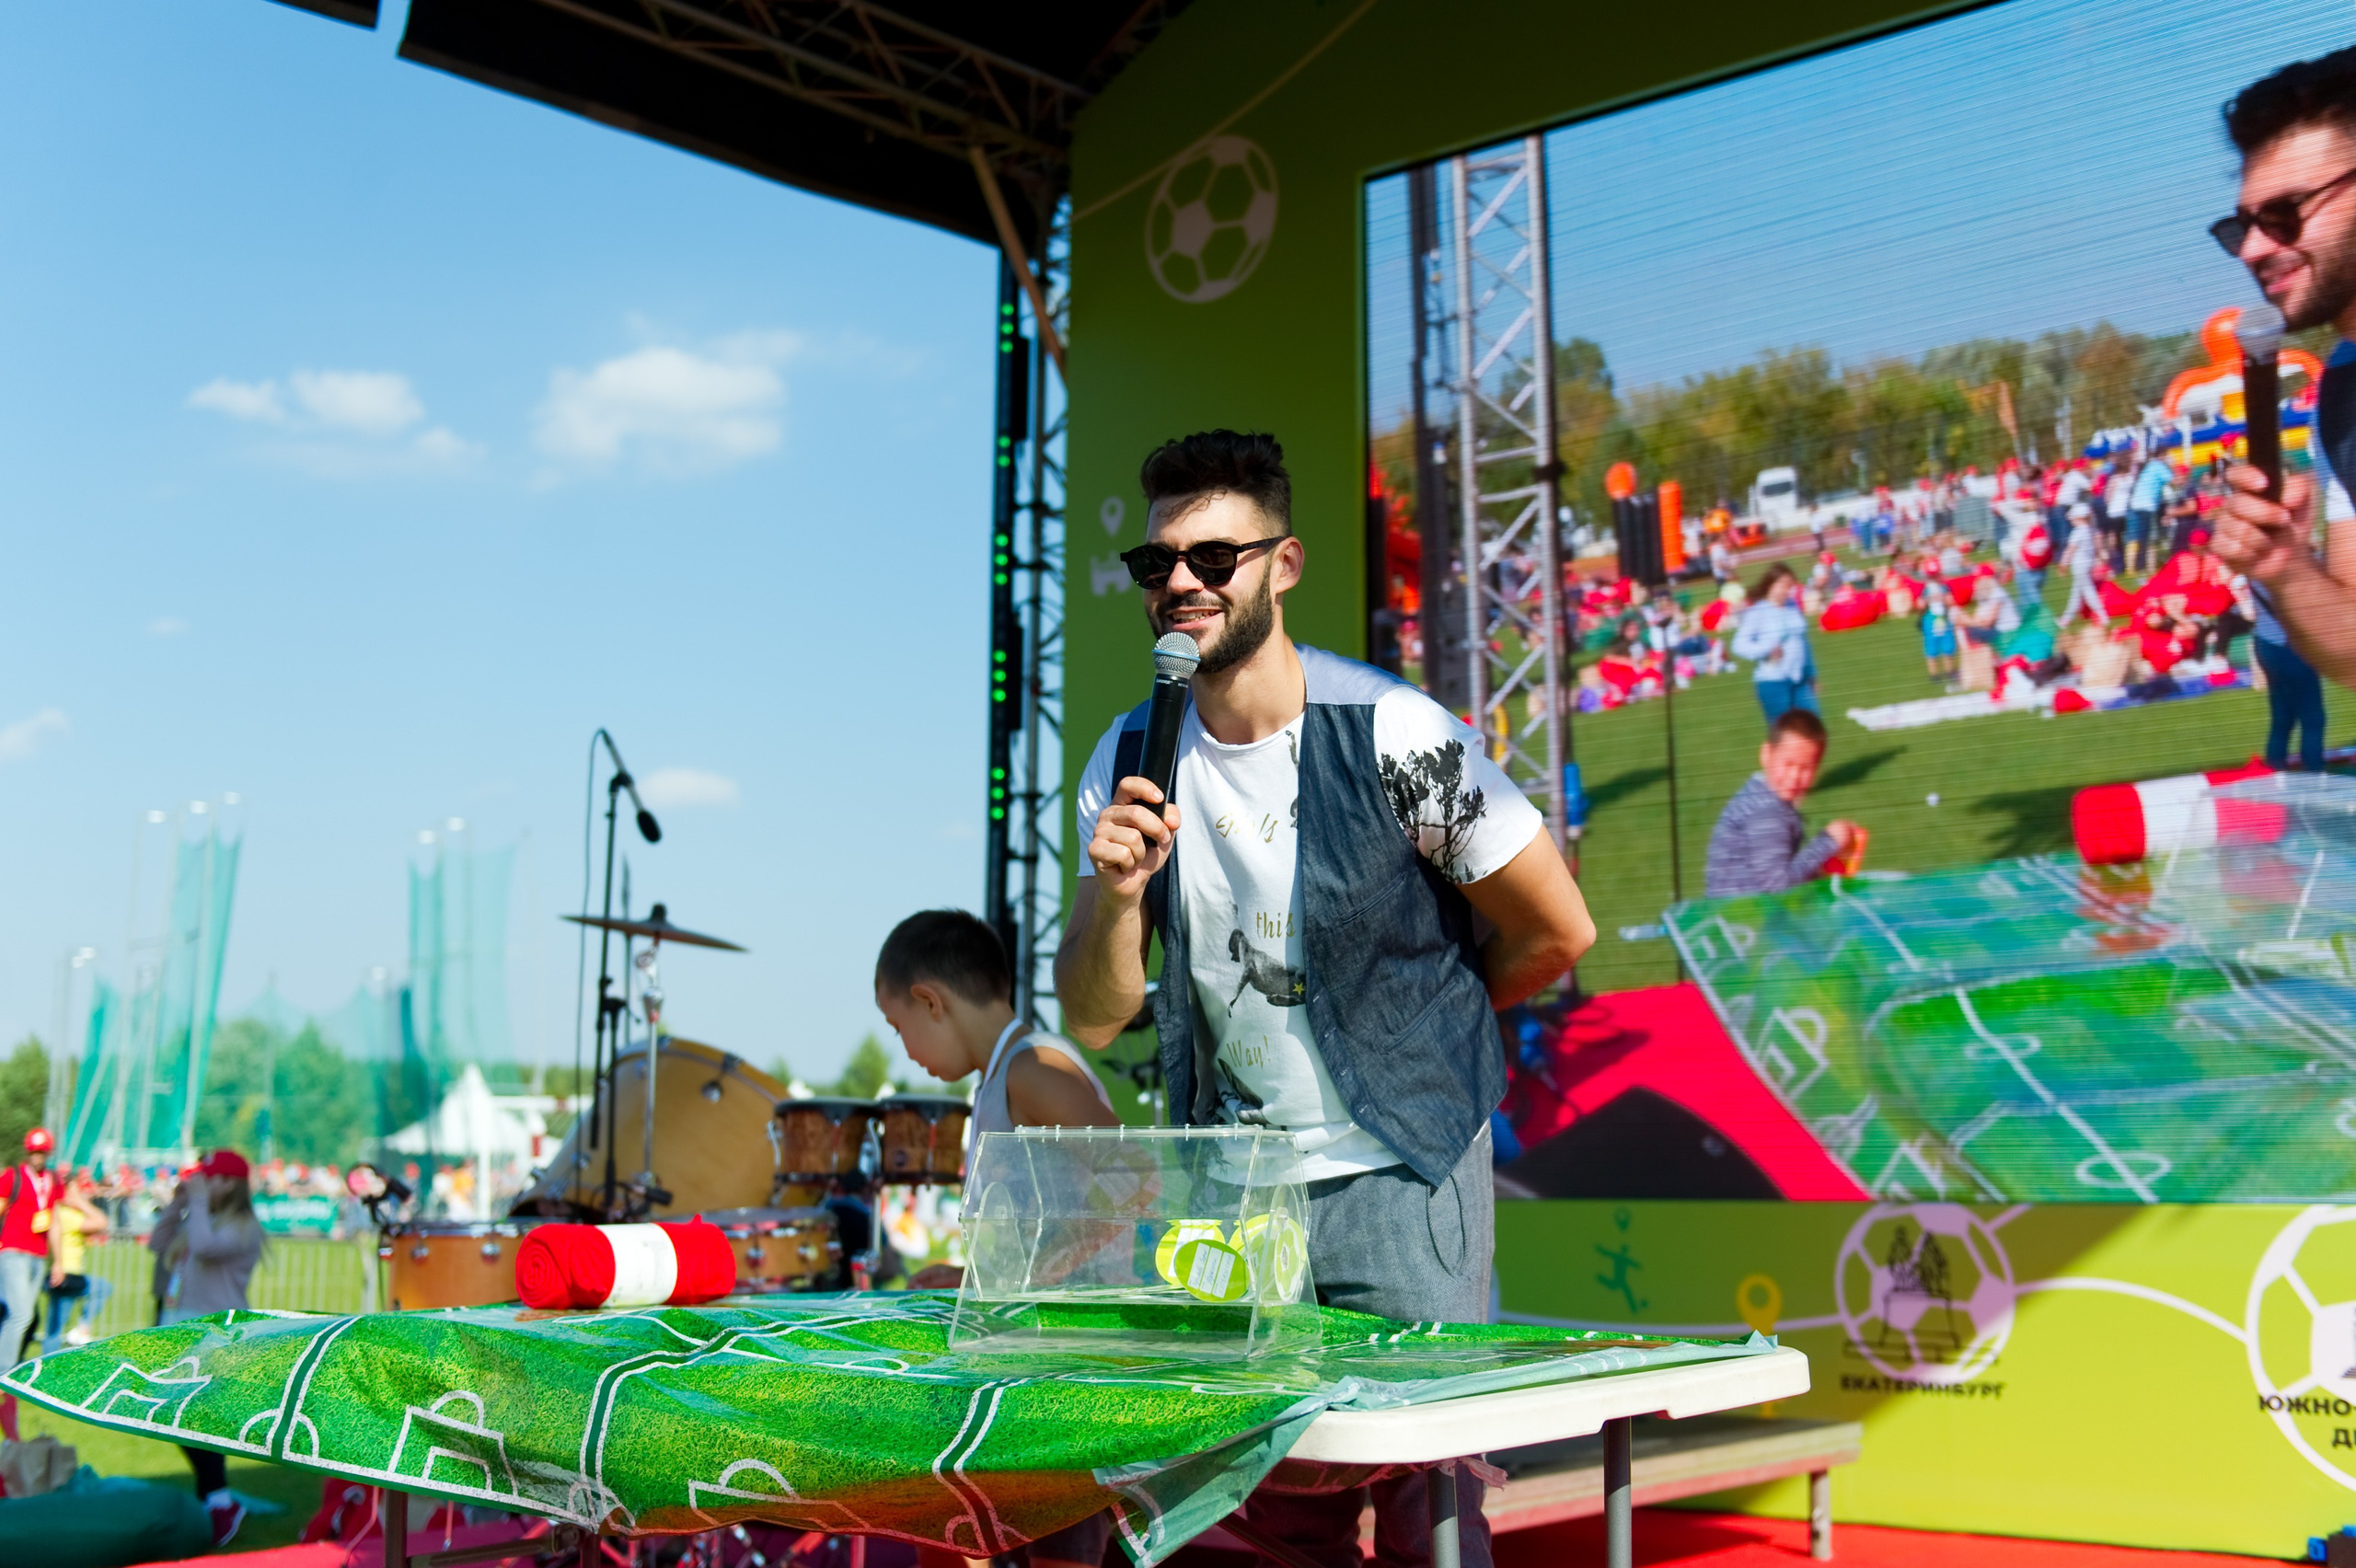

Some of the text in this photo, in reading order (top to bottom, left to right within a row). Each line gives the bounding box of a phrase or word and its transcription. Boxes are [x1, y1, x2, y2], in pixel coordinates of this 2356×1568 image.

[1256, 911, 1296, 940] this
[1227, 1035, 1271, 1068] Way!
[1841, 1375, 2005, 1400] ЕКАТЕРИНБУРГ
